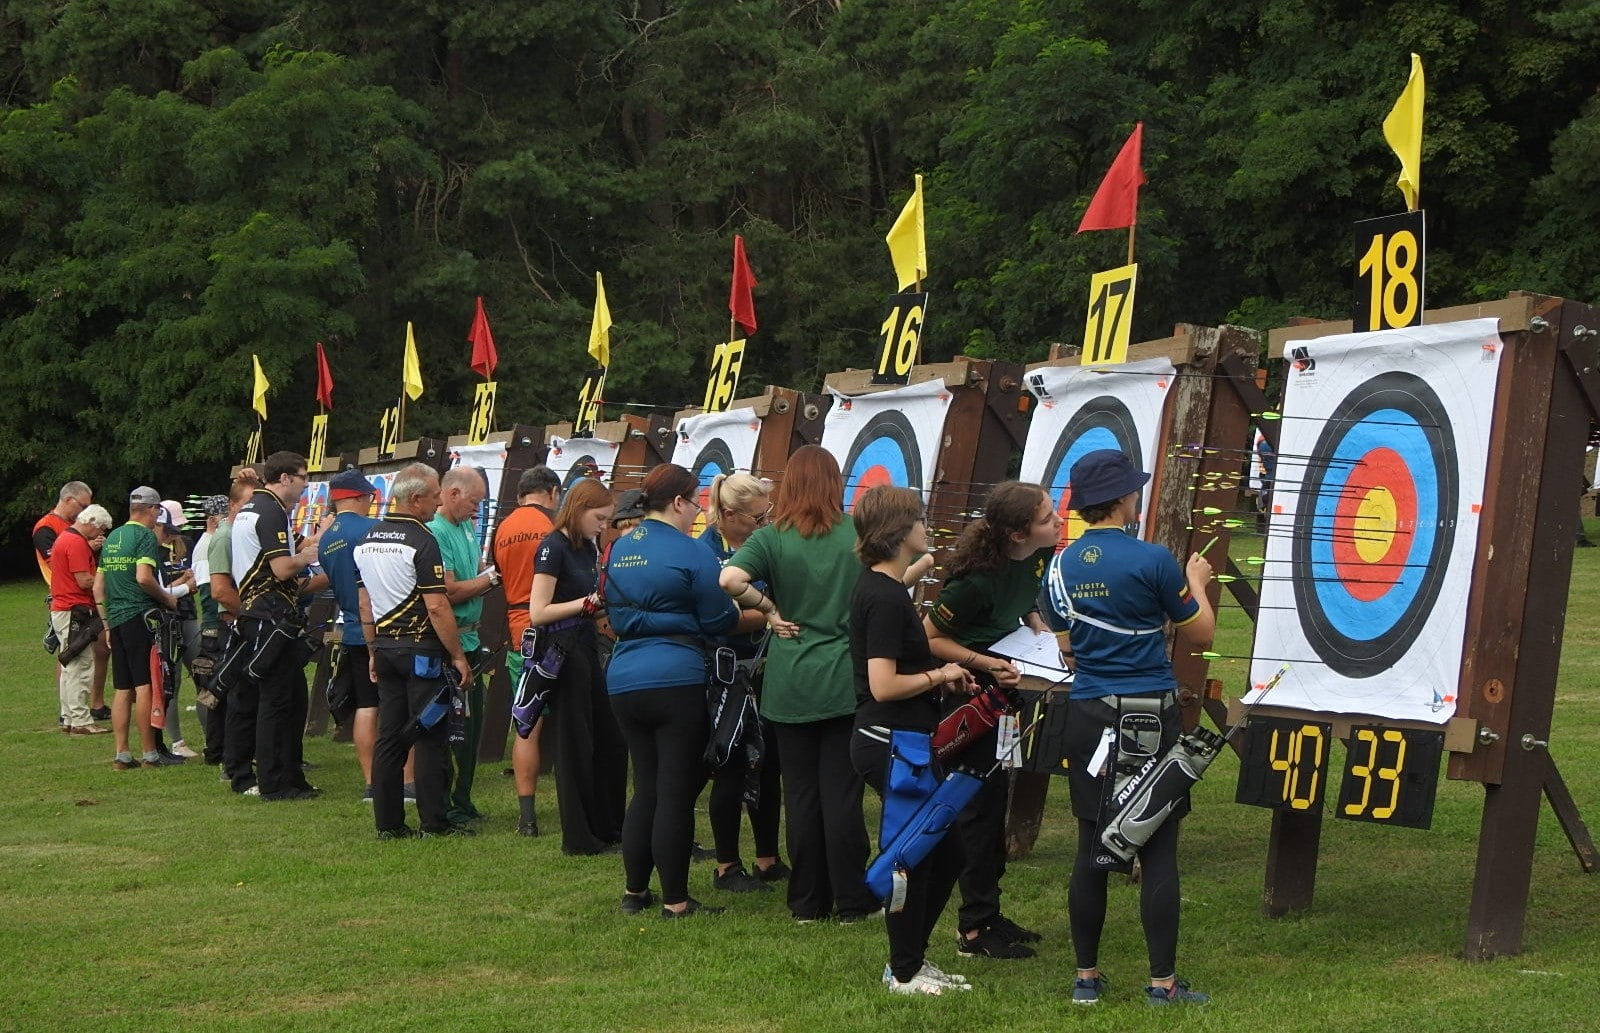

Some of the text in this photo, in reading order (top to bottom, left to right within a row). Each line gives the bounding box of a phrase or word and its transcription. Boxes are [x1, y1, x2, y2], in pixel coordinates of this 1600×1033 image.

[1359, 230, 1418, 331] 18
[878, 305, 922, 376] 16
[1090, 278, 1132, 362] 17
[575, 375, 604, 432] 14
[706, 350, 742, 413] 15
[311, 422, 327, 466] 11
[380, 406, 398, 455] 12
[471, 391, 493, 442] 13
[1075, 582, 1106, 591] LIGITA
[1117, 754, 1157, 806] AVALON
[1269, 724, 1324, 810] 40
[1344, 729, 1407, 819] 33
